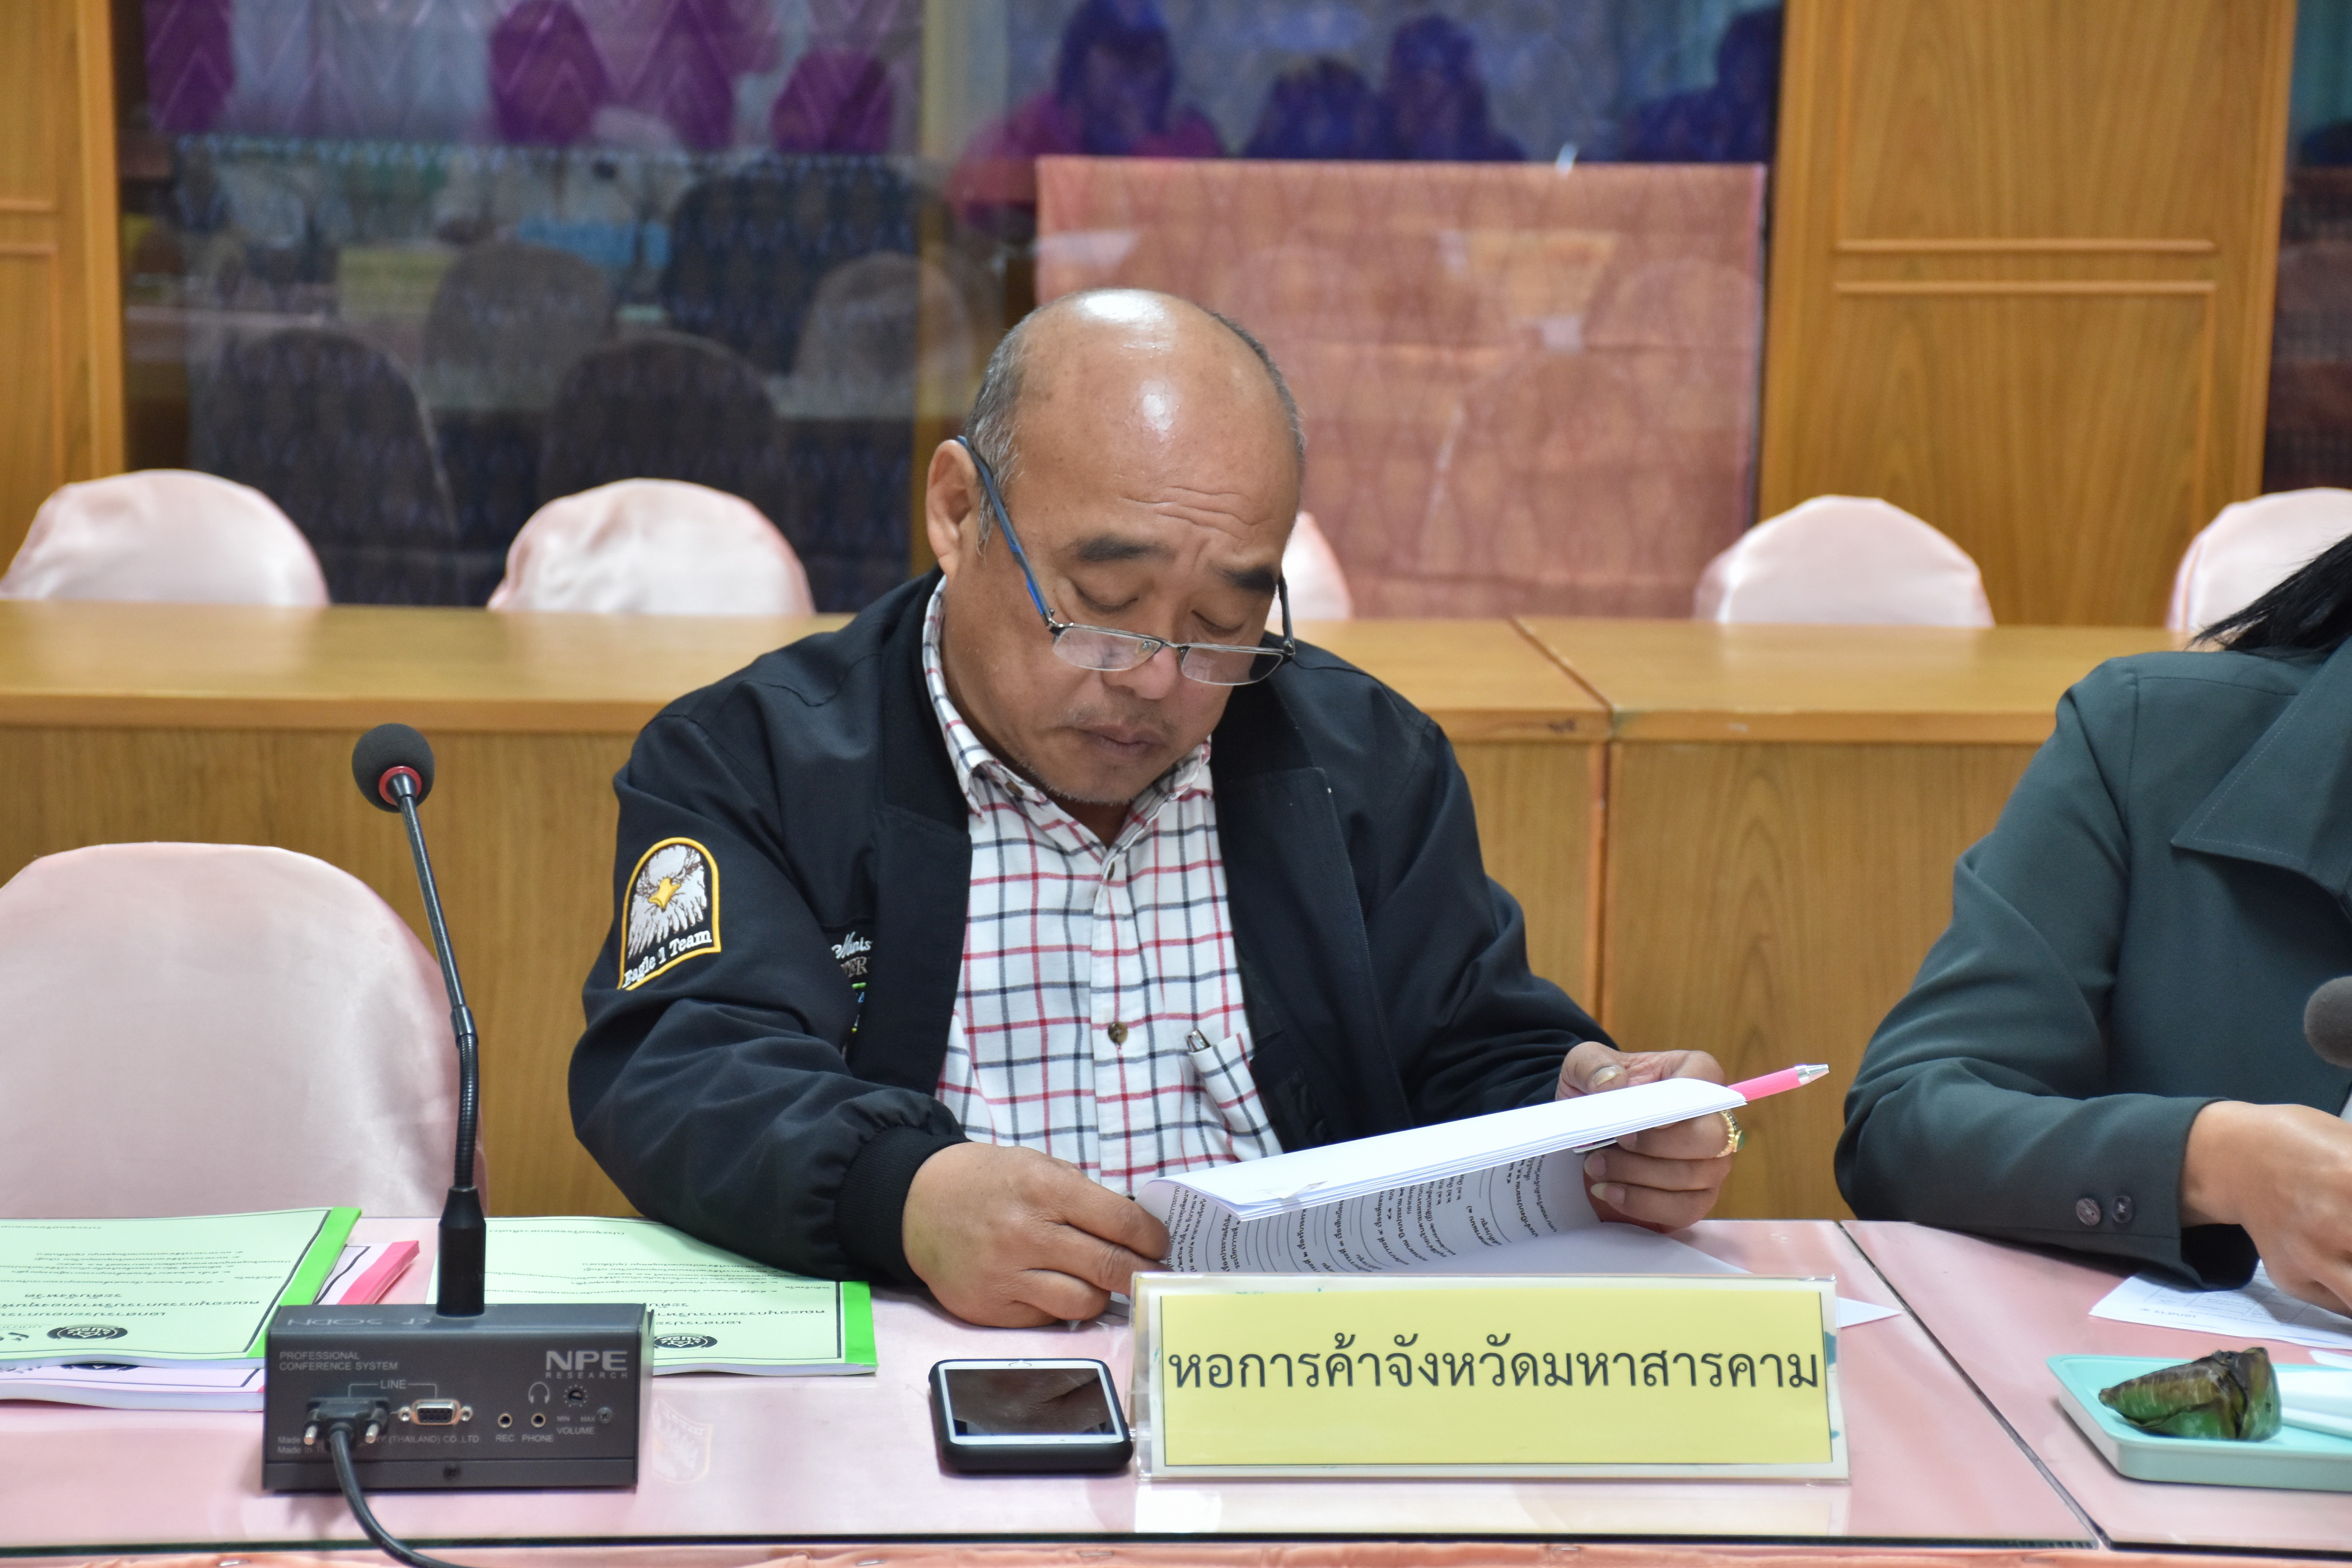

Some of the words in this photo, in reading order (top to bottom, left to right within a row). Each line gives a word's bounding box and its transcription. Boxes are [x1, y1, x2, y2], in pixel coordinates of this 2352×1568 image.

[622, 956, 656, 988] Eagle
[669, 930, 712, 956] Team
[279, 1351, 360, 1360] PROFESSIONAL
[546, 1351, 628, 1371] NPE
[1168, 1332, 1818, 1388] หอการค้าจังหวัดมหาสารคาม
[279, 1362, 351, 1370] CONFERENCE
[355, 1362, 398, 1370] SYSTEM
[380, 1380, 407, 1389] LINE
